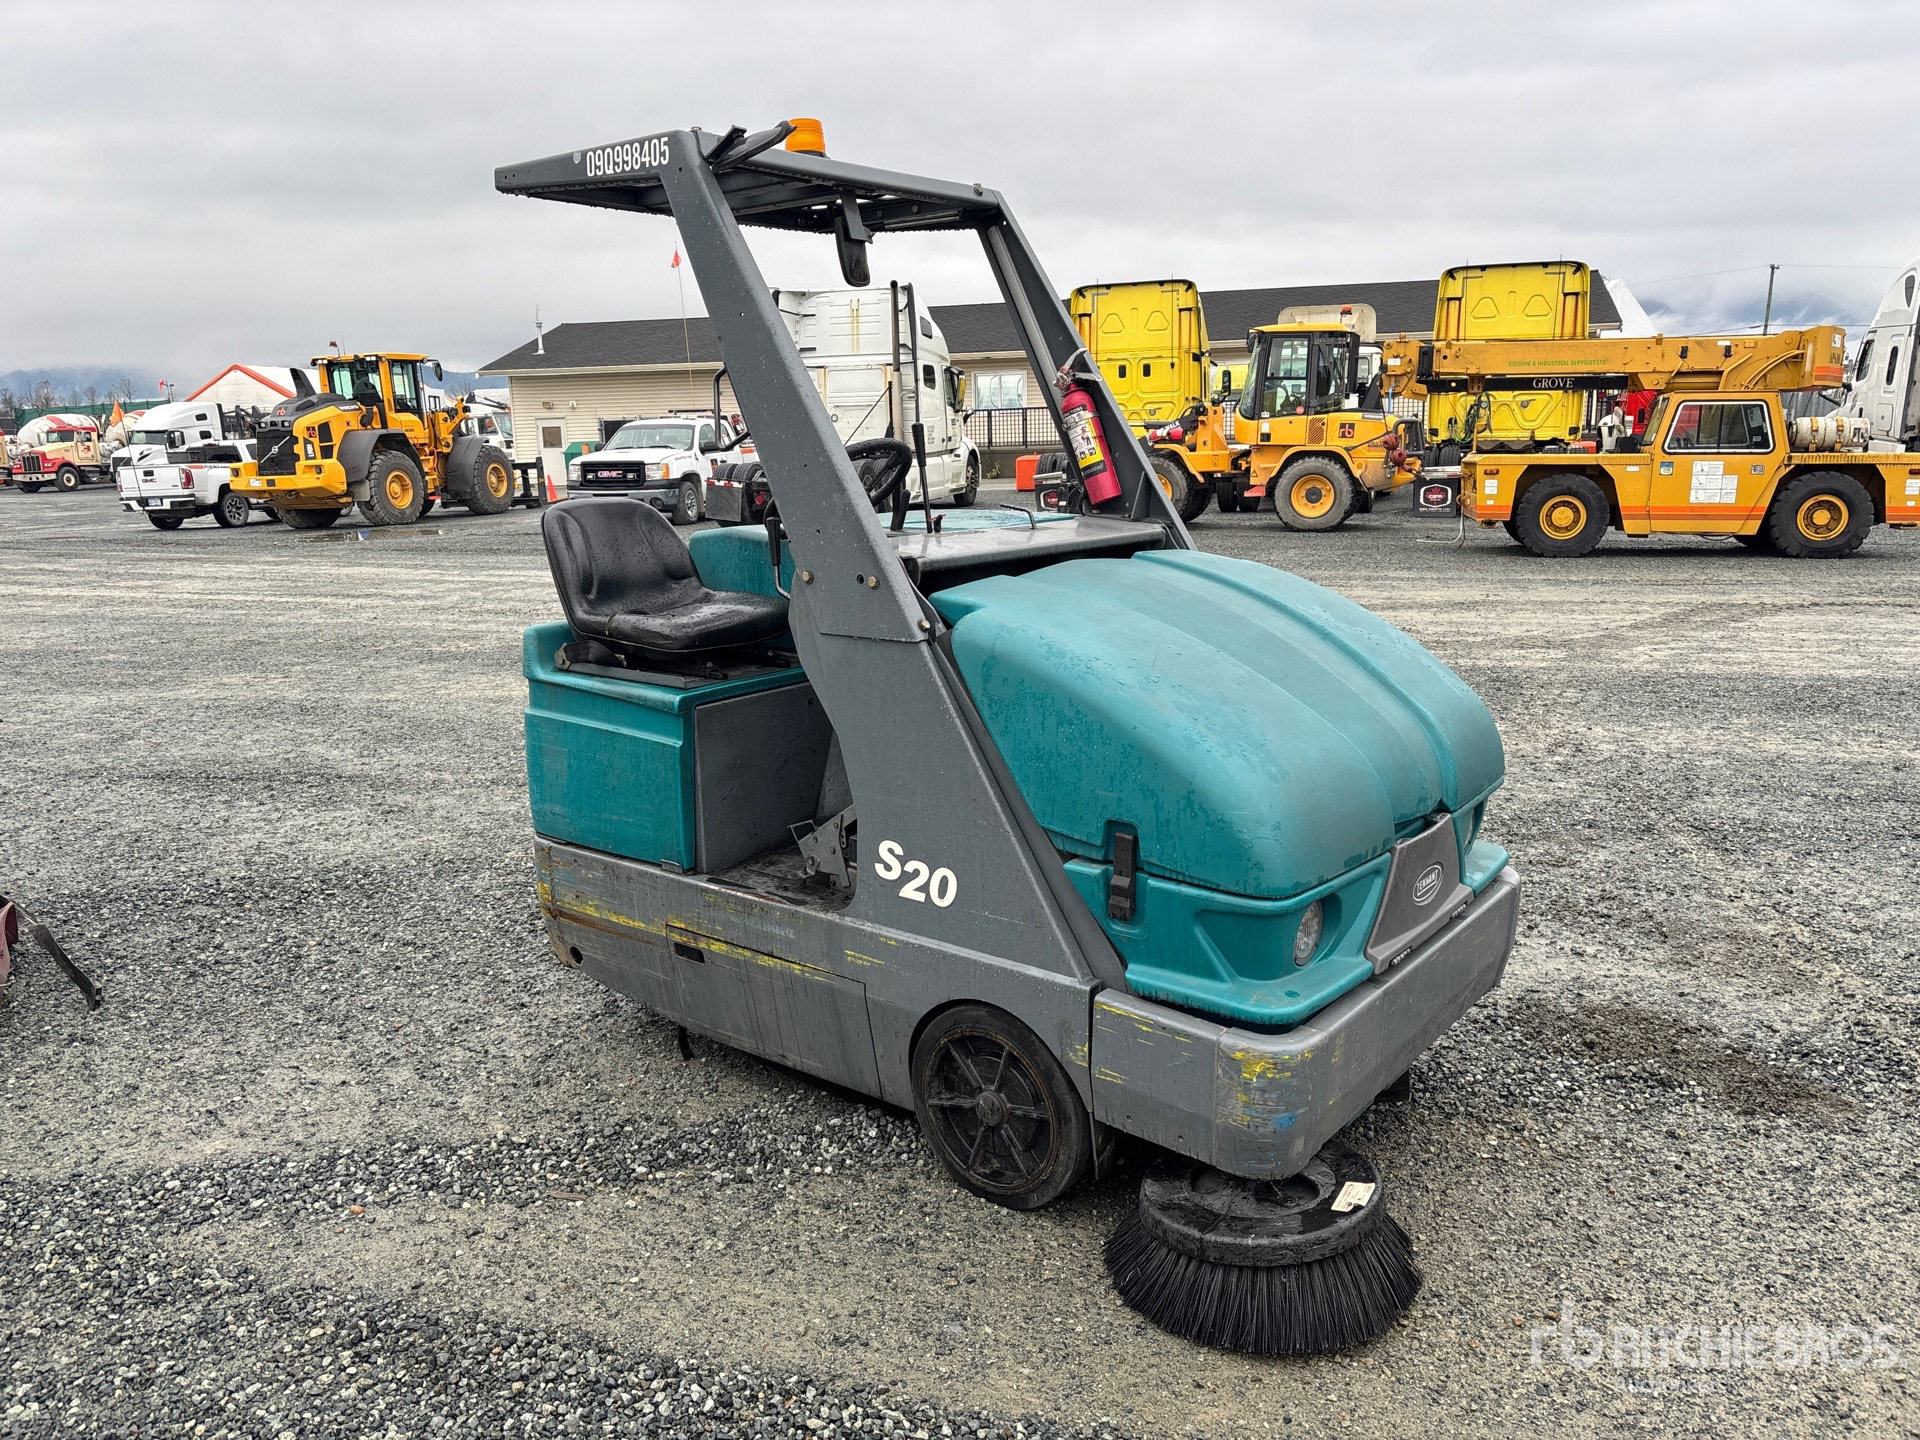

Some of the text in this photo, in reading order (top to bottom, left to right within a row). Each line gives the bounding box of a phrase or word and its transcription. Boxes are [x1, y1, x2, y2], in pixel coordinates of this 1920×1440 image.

[587, 137, 669, 177] 09Q998405
[1532, 377, 1575, 389] GROVE
[1339, 423, 1354, 438] rb
[597, 470, 623, 478] GMC
[874, 840, 958, 908] S20
